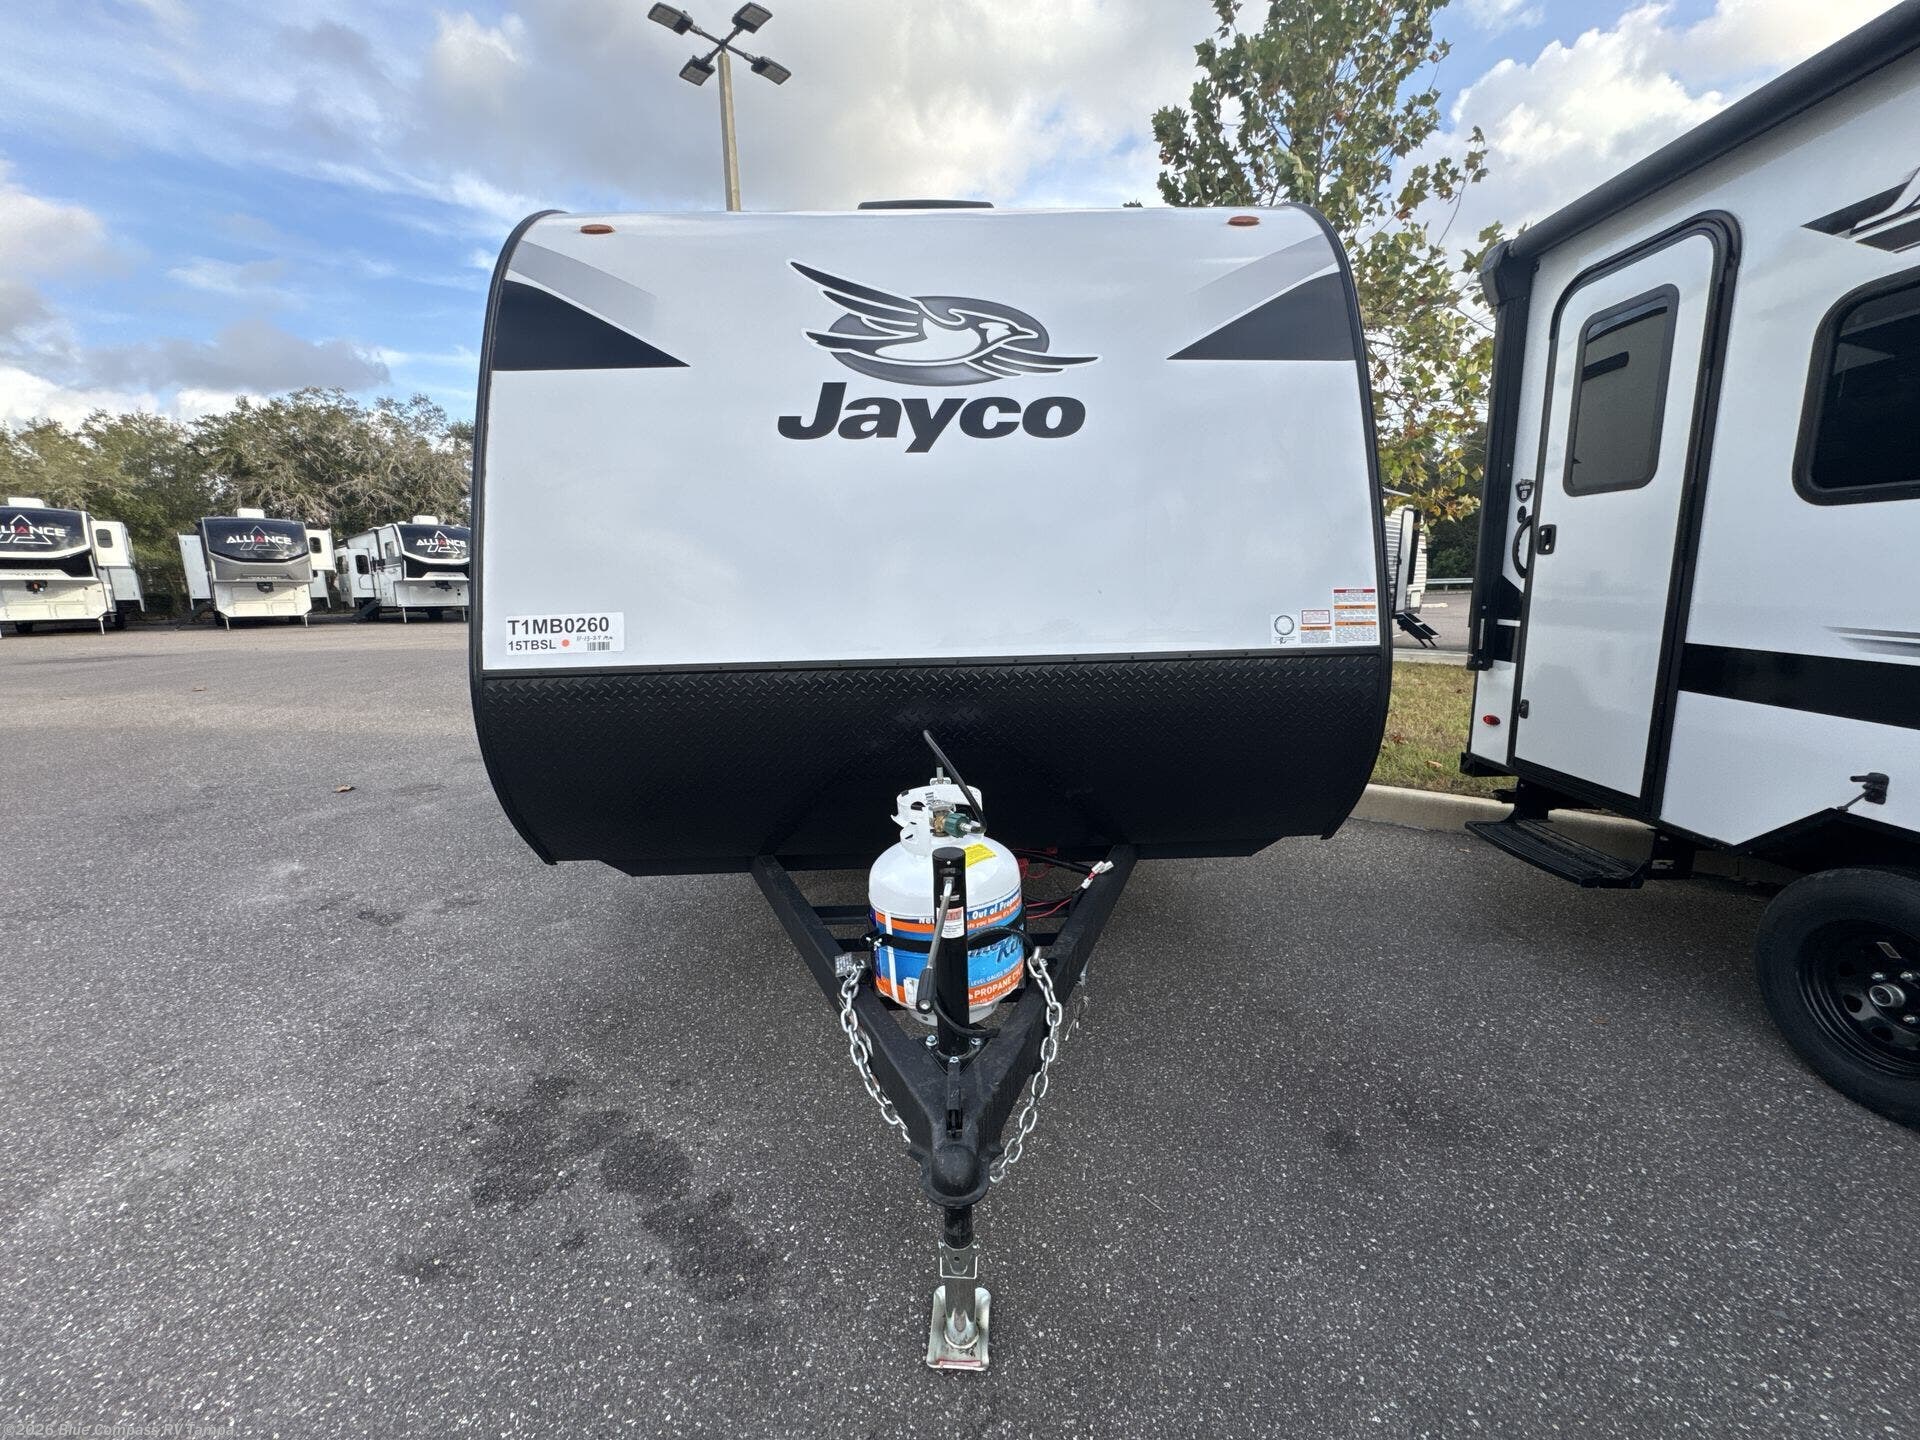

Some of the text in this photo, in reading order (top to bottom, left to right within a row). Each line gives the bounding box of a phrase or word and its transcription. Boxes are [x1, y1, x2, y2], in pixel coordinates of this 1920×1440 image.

[777, 381, 1087, 453] Jayco
[0, 525, 66, 537] LIANCE
[226, 534, 293, 546] ALLIANCE
[416, 537, 467, 548] ALLIANCE
[507, 616, 610, 635] T1MB0260
[508, 639, 557, 651] 15TBSL
[972, 908, 988, 920] Out
[974, 975, 1012, 999] PROPANE
